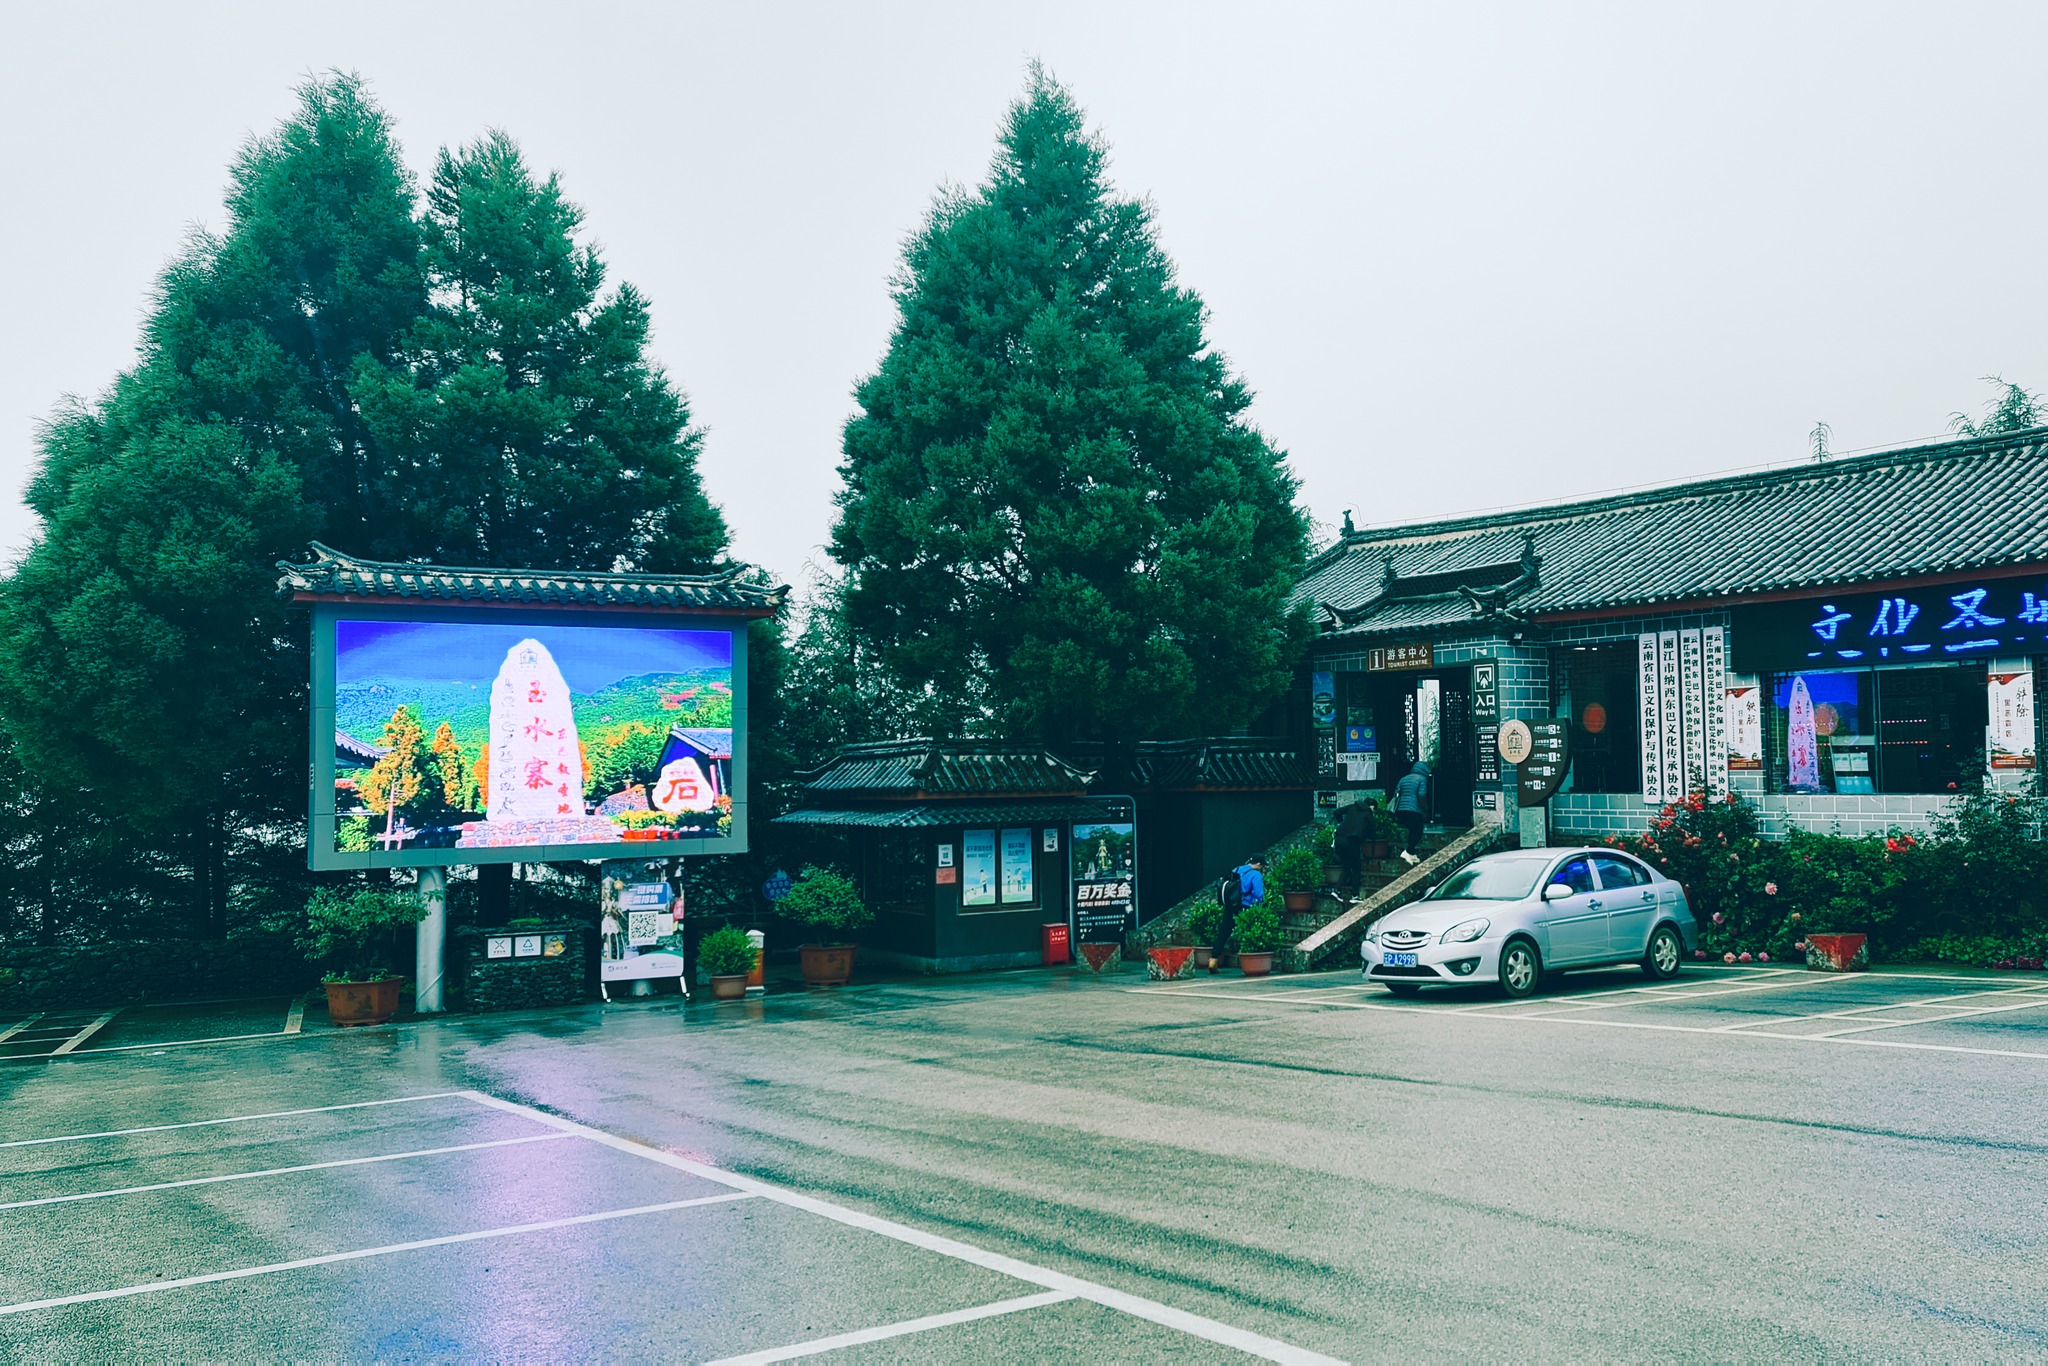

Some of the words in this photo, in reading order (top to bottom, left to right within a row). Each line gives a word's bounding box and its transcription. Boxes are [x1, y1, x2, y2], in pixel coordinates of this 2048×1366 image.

[1387, 645, 1428, 661] 游客中心
[1408, 659, 1429, 667] CENTRE
[1475, 694, 1496, 708] 入口
[1475, 709, 1489, 717] Way
[1643, 639, 1658, 796] 云南省东巴文化保护与传承协会
[1663, 637, 1679, 796] 丽江市纳西东巴文化传承协会
[1714, 633, 1726, 796] 云南省东巴文化保护与传承协会
[523, 680, 554, 790] 玉水寨
[662, 778, 699, 804] 石
[1077, 882, 1132, 900] 百万奖金
